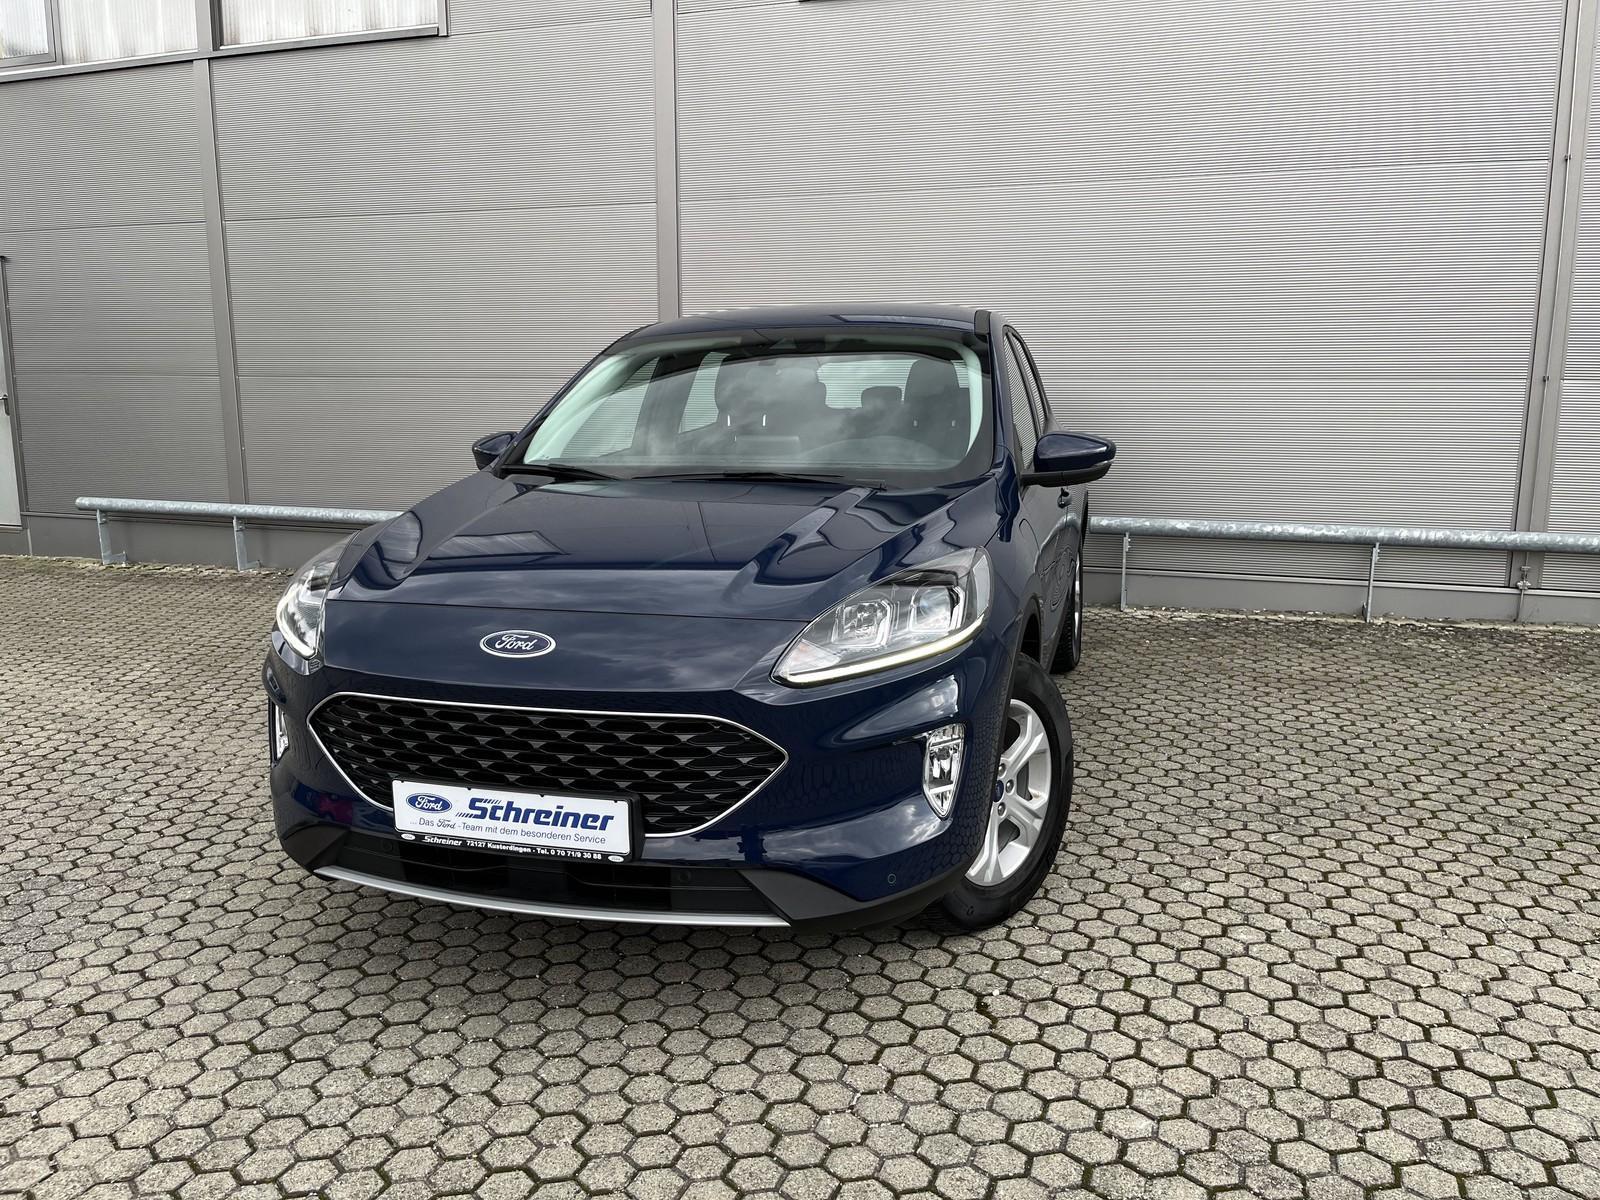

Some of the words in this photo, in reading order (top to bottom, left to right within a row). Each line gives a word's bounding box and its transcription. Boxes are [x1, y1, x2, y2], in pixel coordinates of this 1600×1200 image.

[495, 634, 538, 650] Ford
[415, 795, 443, 811] Ford
[467, 797, 615, 831] Schreiner
[436, 818, 456, 829] Ford
[485, 825, 498, 834] mit
[500, 826, 518, 836] dem
[520, 828, 571, 841] besonderen
[573, 833, 606, 844] Service
[422, 835, 462, 846] Schreiner
